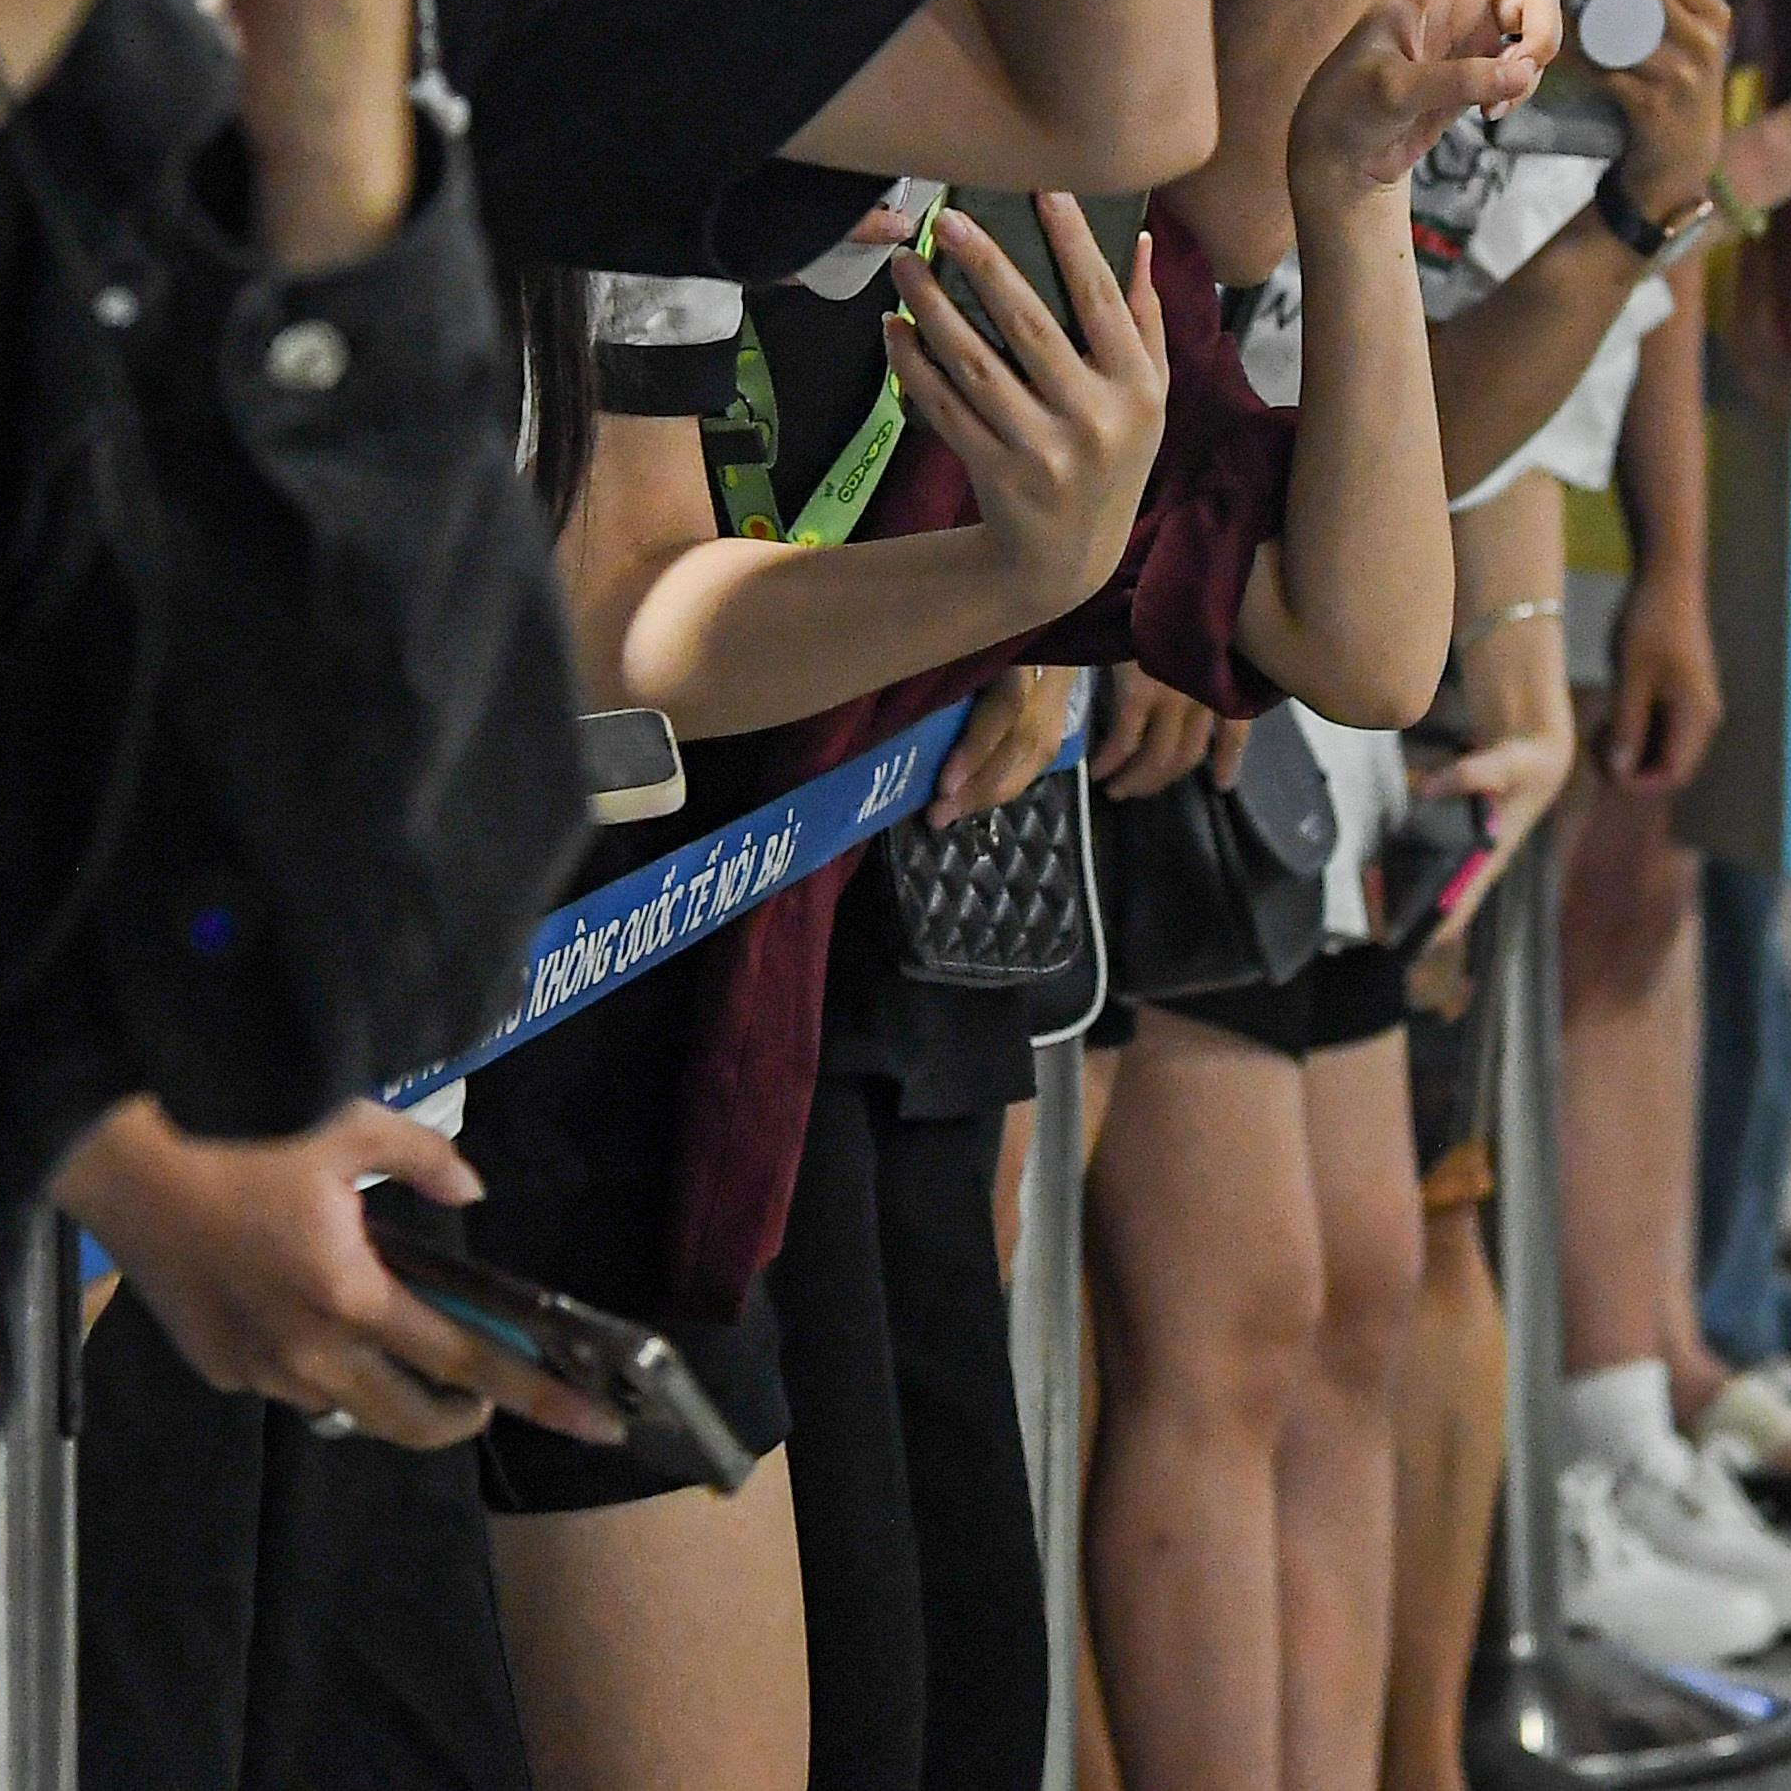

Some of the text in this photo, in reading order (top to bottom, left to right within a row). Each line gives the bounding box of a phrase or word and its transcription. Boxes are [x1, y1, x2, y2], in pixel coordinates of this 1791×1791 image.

[525, 917, 621, 1023] KHÔNG
[614, 864, 686, 974] QUỐC
[679, 839, 725, 937] TẾ
[707, 831, 759, 926] NỘI
